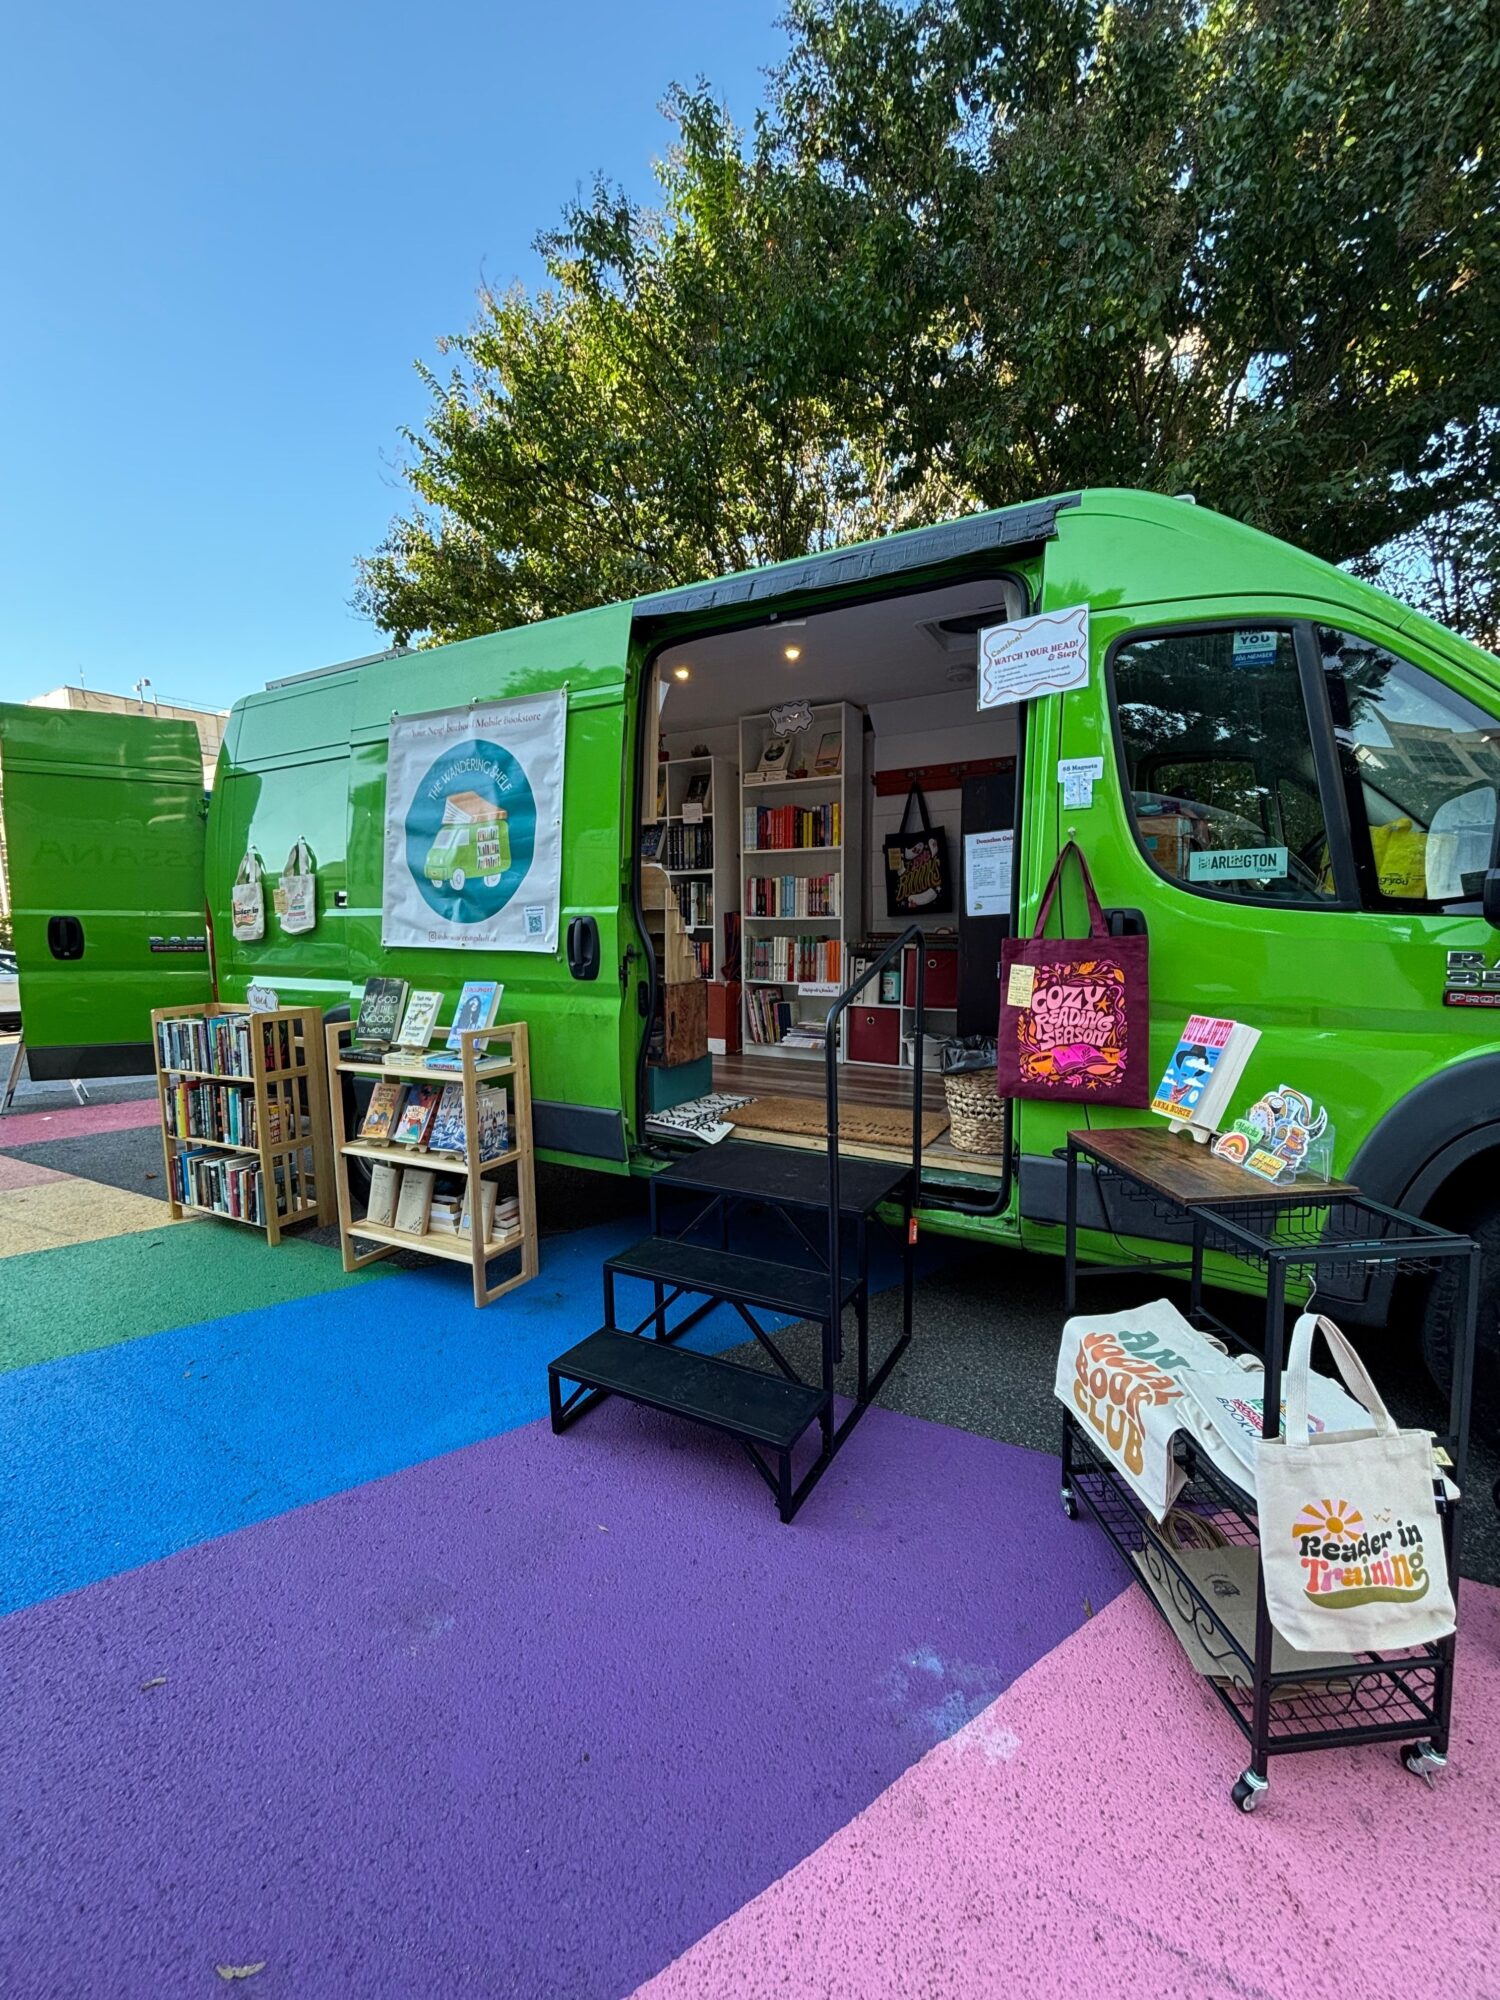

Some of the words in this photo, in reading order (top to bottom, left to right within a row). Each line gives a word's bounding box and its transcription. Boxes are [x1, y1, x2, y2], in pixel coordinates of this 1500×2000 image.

[994, 652, 1024, 666] WATCH
[1025, 646, 1049, 658] YOUR
[1050, 639, 1079, 652] HEAD!
[1240, 634, 1271, 644] YOU
[1057, 650, 1078, 660] Step
[475, 715, 502, 729] Mobile
[503, 711, 542, 726] Bookstore
[427, 780, 444, 801] THE
[441, 757, 492, 784] WANDERING
[489, 763, 513, 793] SHELF
[1210, 853, 1277, 869] ARLINGTON
[149, 936, 205, 944] RAM
[377, 994, 398, 1004] GOD
[1031, 984, 1107, 1014] COZY
[361, 1011, 395, 1024] WOODS
[367, 1026, 392, 1034] MOORE
[1034, 1005, 1116, 1040] READING
[1040, 1025, 1112, 1052] SEASON
[1182, 1016, 1234, 1048] OUTLAWED
[1153, 1098, 1169, 1111] ANNA
[1170, 1102, 1193, 1118] NORTH
[1084, 1332, 1185, 1407] SOCIAL
[1075, 1339, 1153, 1440] BOOK
[1073, 1378, 1144, 1476] CLUB
[1216, 1396, 1263, 1438] BOOKW
[1299, 1532, 1393, 1563] Reader
[1397, 1519, 1423, 1548] in
[1300, 1544, 1430, 1598] Training
